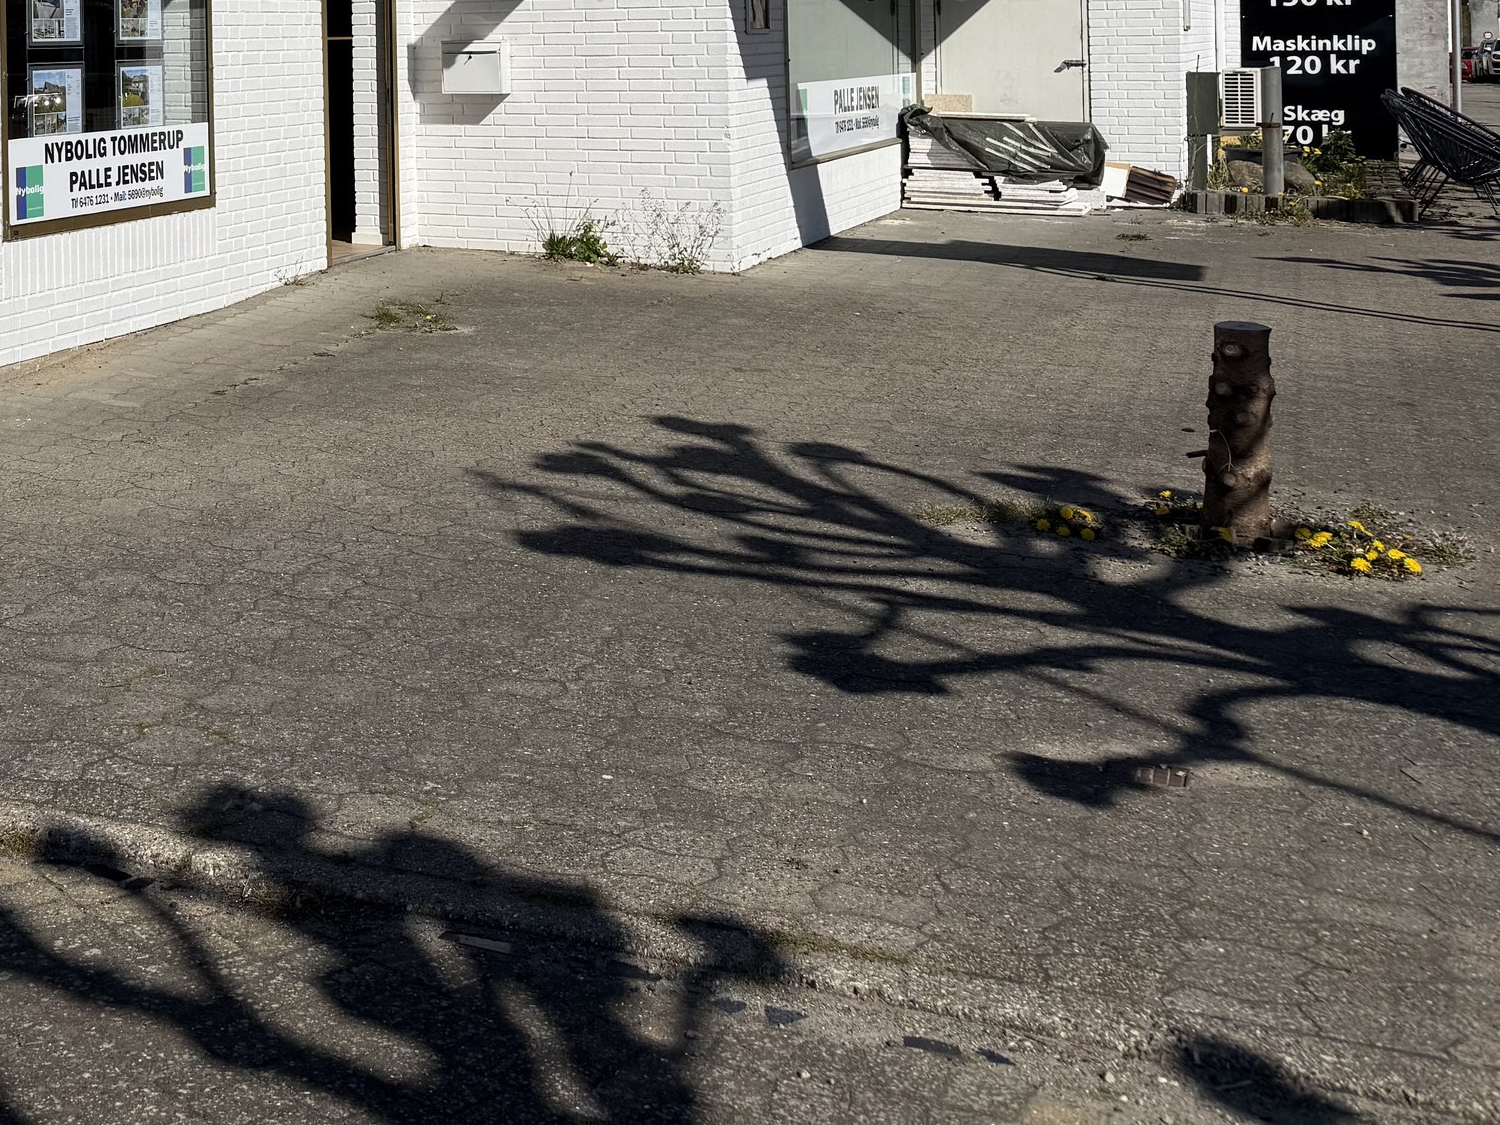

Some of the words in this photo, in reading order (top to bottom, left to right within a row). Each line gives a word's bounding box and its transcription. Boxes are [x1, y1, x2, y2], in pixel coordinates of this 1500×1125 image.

[1252, 35, 1377, 55] Maskinklip
[1269, 56, 1322, 75] 120
[1330, 54, 1360, 74] kr
[833, 87, 855, 115] PALLE
[856, 85, 880, 111] JENSEN
[1283, 105, 1345, 125] Skæg
[44, 138, 107, 165] NYBOLIG
[110, 129, 184, 156] TOMMERUP
[69, 165, 112, 193] PALLE
[115, 160, 164, 186] JENSEN
[95, 193, 110, 206] 1231
